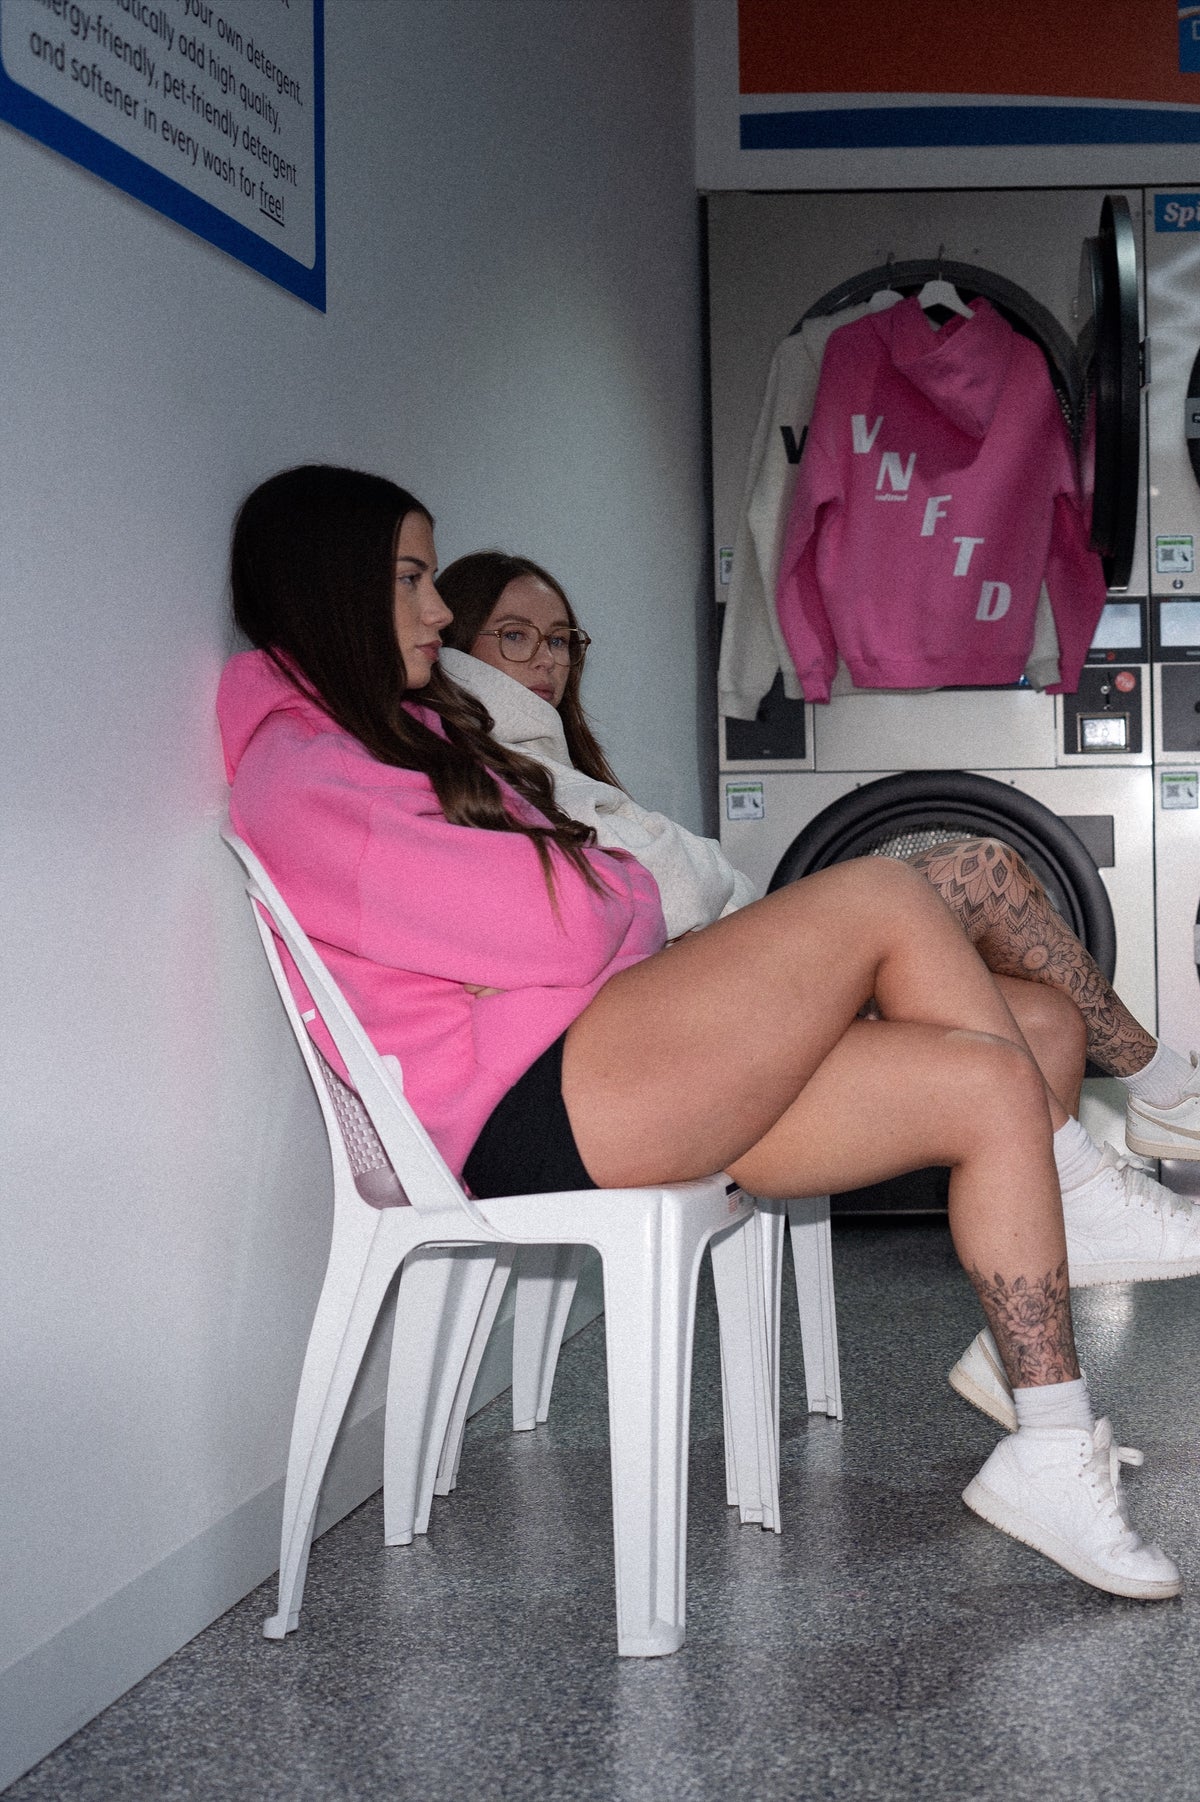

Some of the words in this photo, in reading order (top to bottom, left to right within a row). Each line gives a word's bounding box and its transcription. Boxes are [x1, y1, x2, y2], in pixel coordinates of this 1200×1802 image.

[179, 34, 205, 69] add
[209, 49, 236, 95] high
[240, 83, 281, 135] quality,
[218, 18, 243, 55] own
[247, 38, 303, 106] detergent.
[30, 32, 65, 72] and
[71, 58, 140, 120] softener
[144, 99, 158, 134] in
[161, 120, 199, 166] every
[202, 146, 236, 188] wash
[240, 166, 256, 200] for
[259, 181, 285, 222] free!
[163, 71, 239, 148] pet-friendly
[243, 125, 298, 187] detergent
